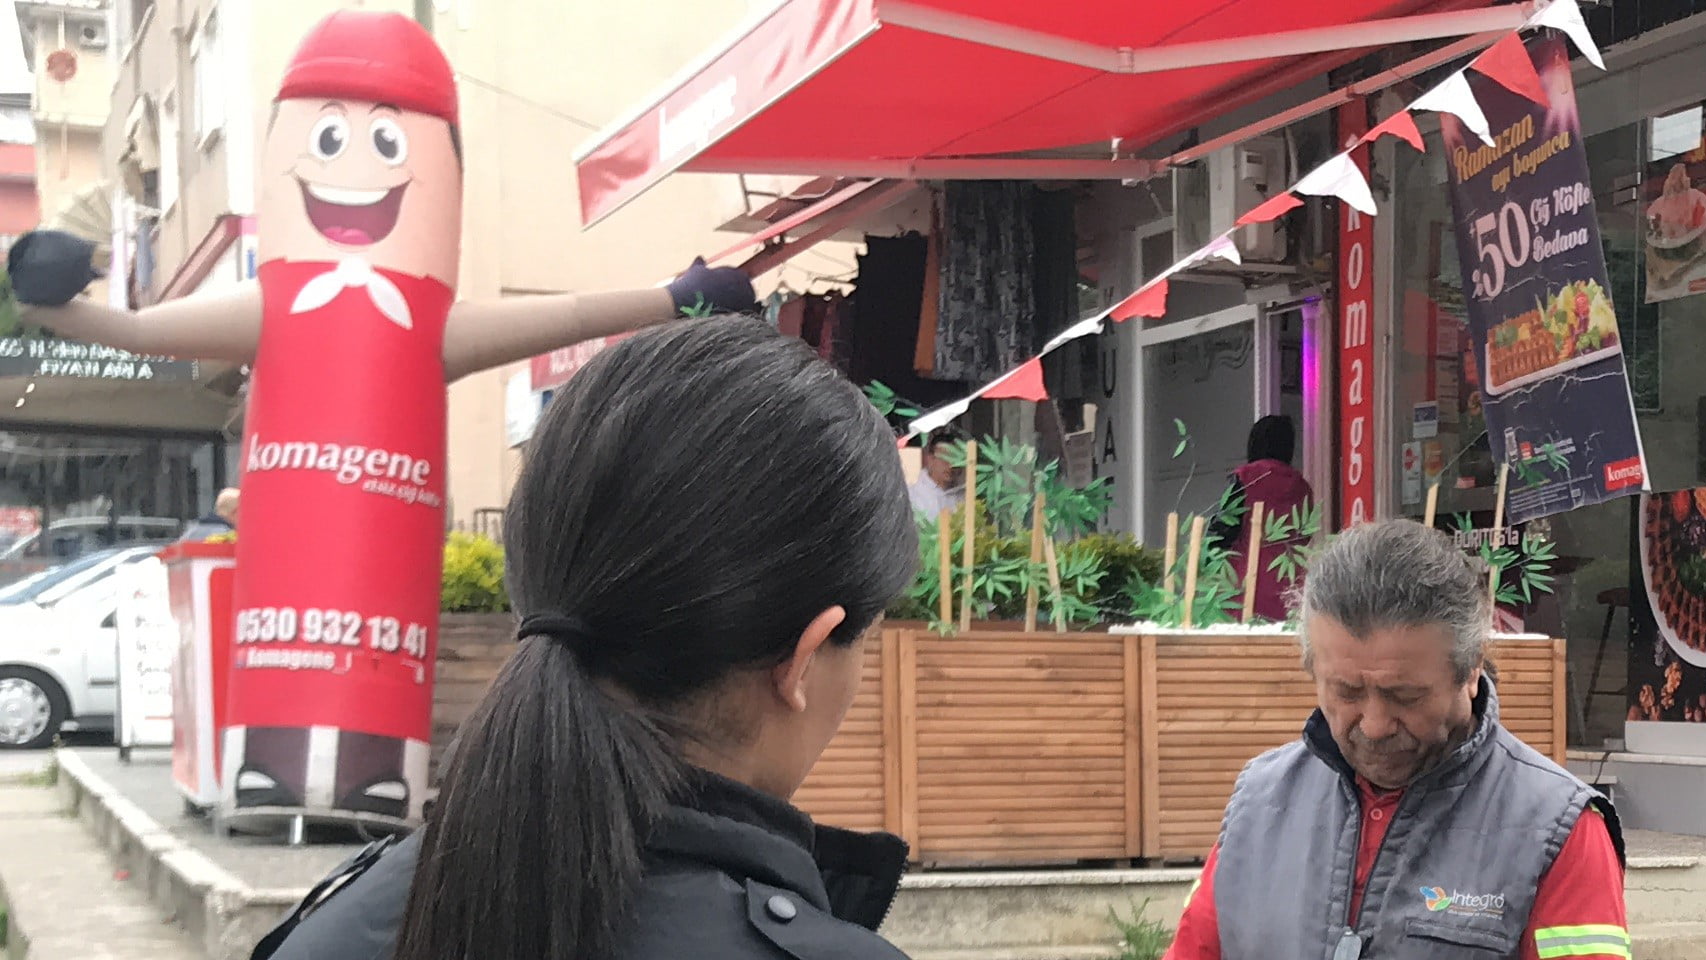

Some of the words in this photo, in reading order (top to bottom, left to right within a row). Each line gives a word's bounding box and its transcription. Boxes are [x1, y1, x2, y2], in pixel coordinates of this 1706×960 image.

[1454, 114, 1534, 184] Ramazan
[1553, 182, 1590, 216] Köfte
[1533, 227, 1588, 262] Bedava
[246, 433, 431, 486] komagene
[236, 607, 298, 645] 0530
[302, 608, 363, 647] 932
[366, 615, 400, 651] 13
[402, 623, 427, 659] 41
